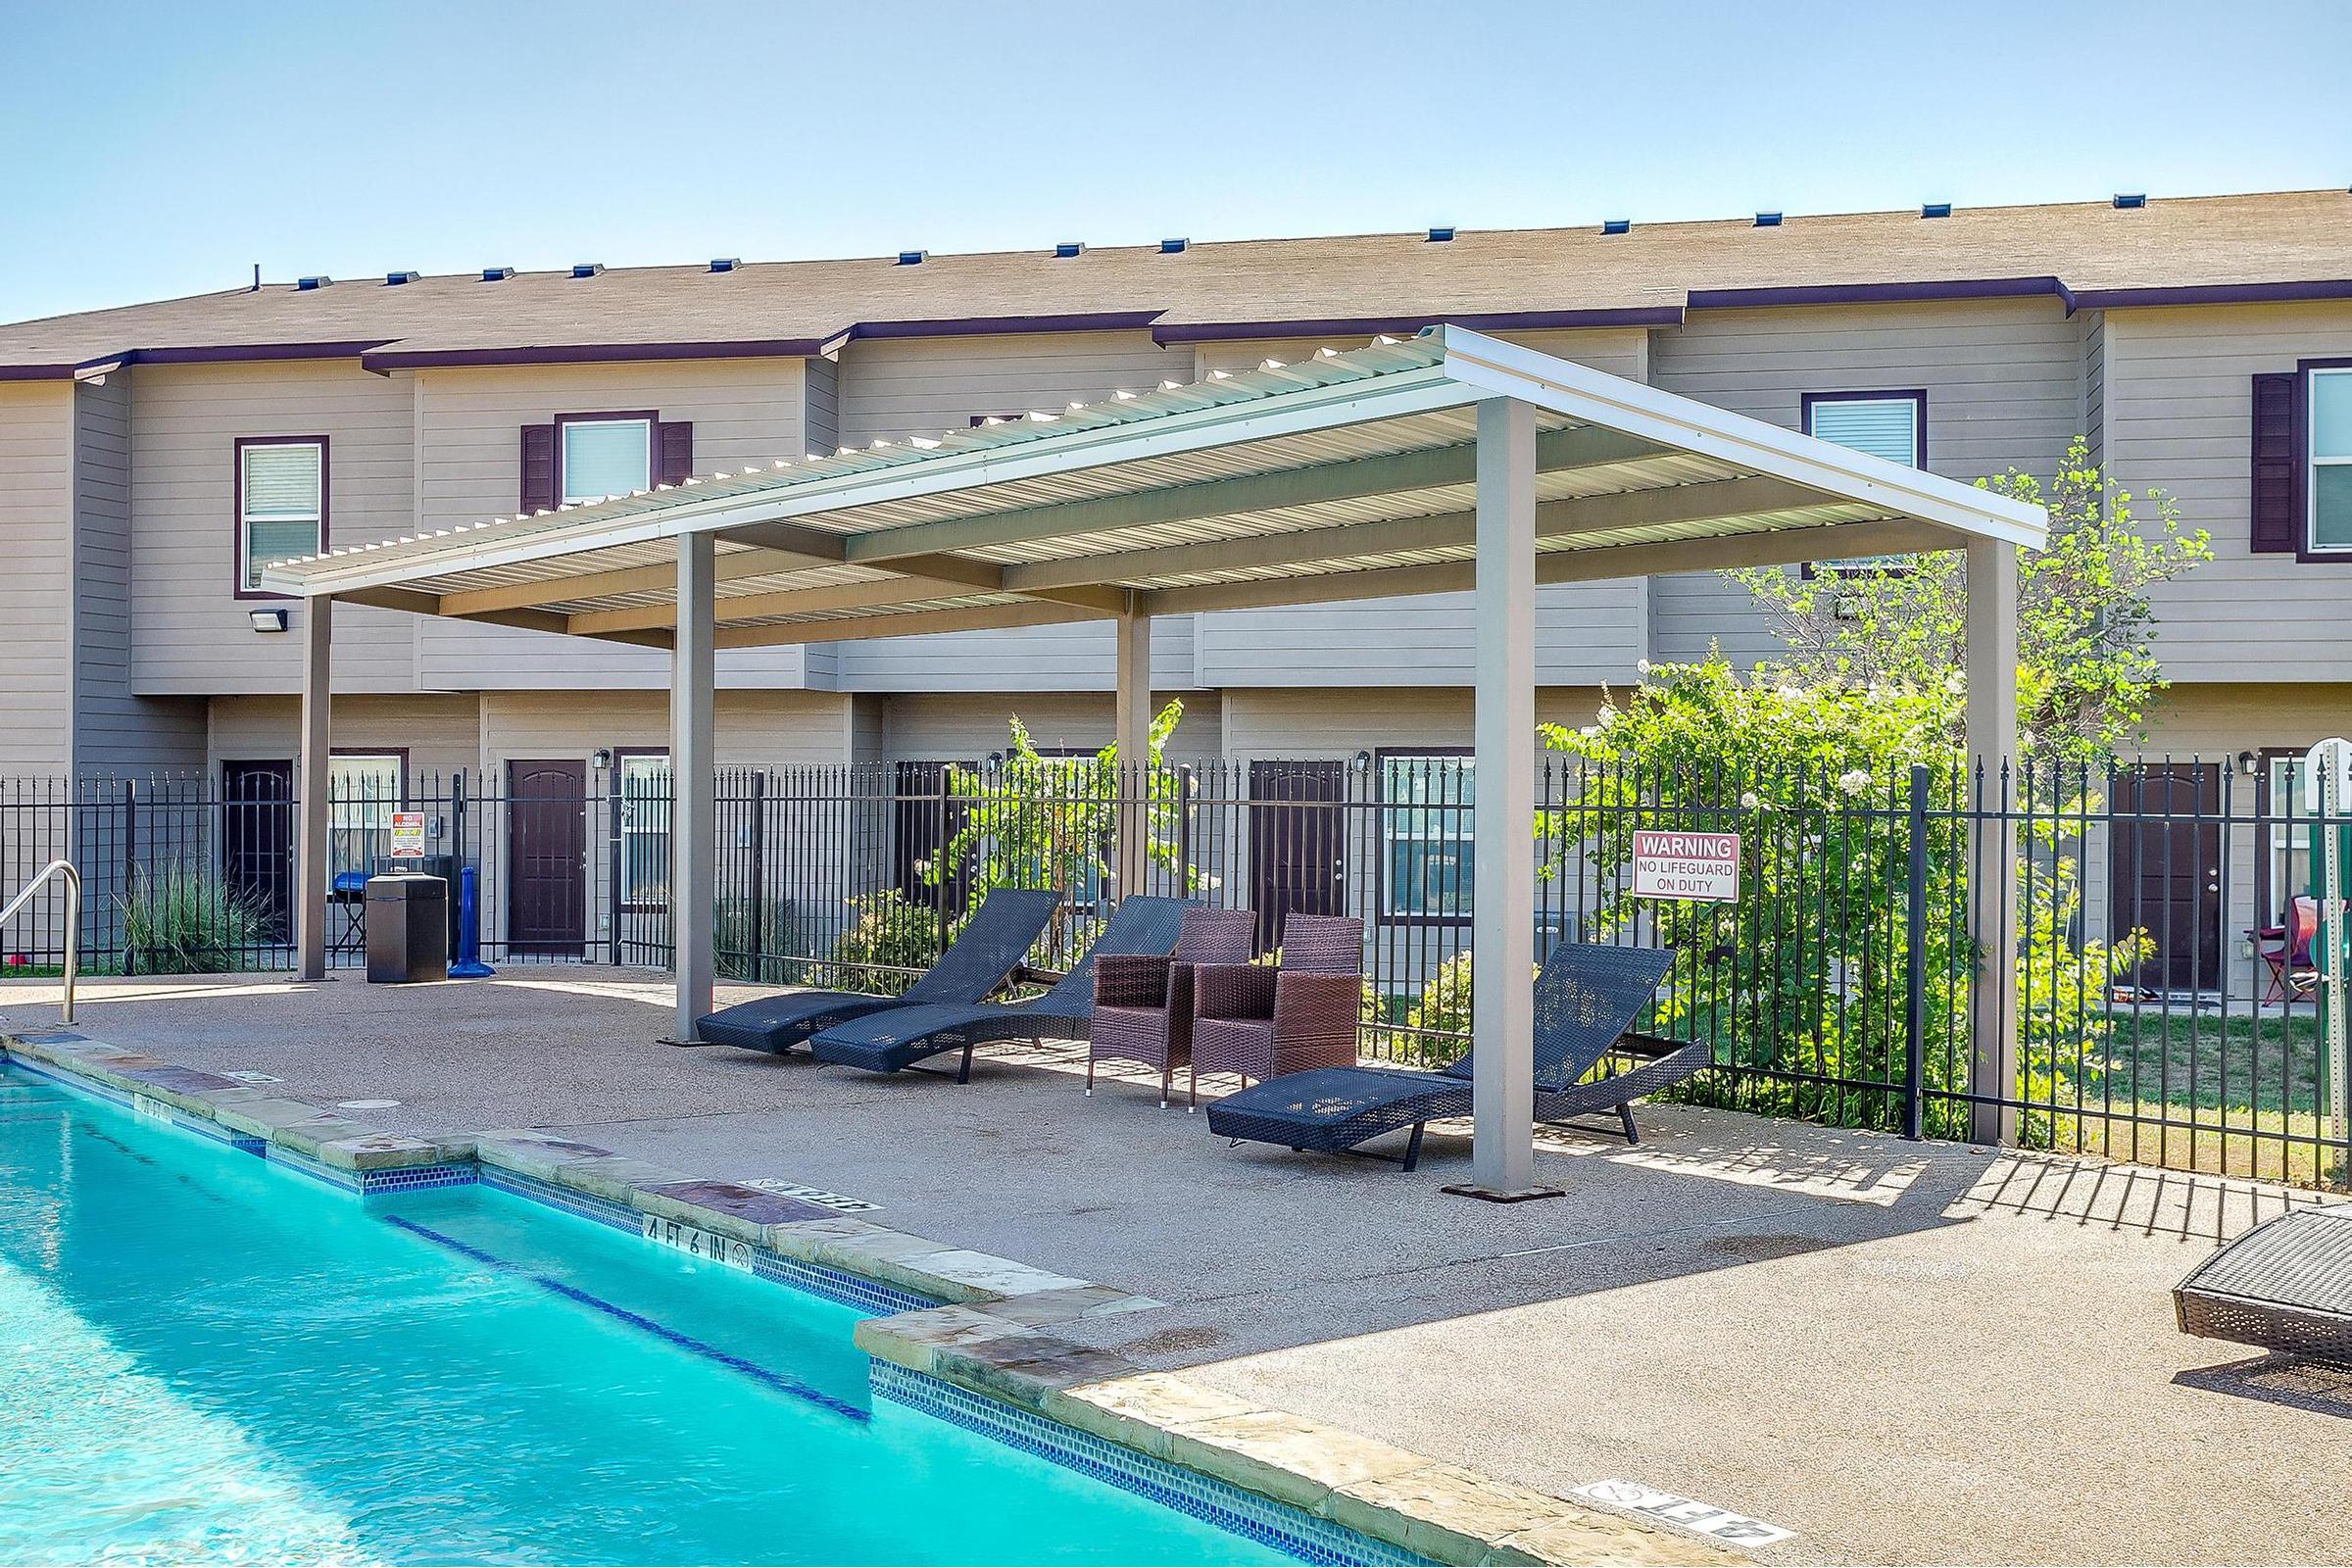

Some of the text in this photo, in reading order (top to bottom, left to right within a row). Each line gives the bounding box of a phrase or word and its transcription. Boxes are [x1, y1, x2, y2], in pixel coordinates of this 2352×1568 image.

[1641, 836, 1732, 858] WARNING
[1639, 860, 1734, 876] NO LIFEGUARD
[1656, 878, 1713, 892] ON DUTY
[648, 1217, 725, 1262] 4 FT 6 IN
[1633, 1499, 1775, 1538] 4 FT
